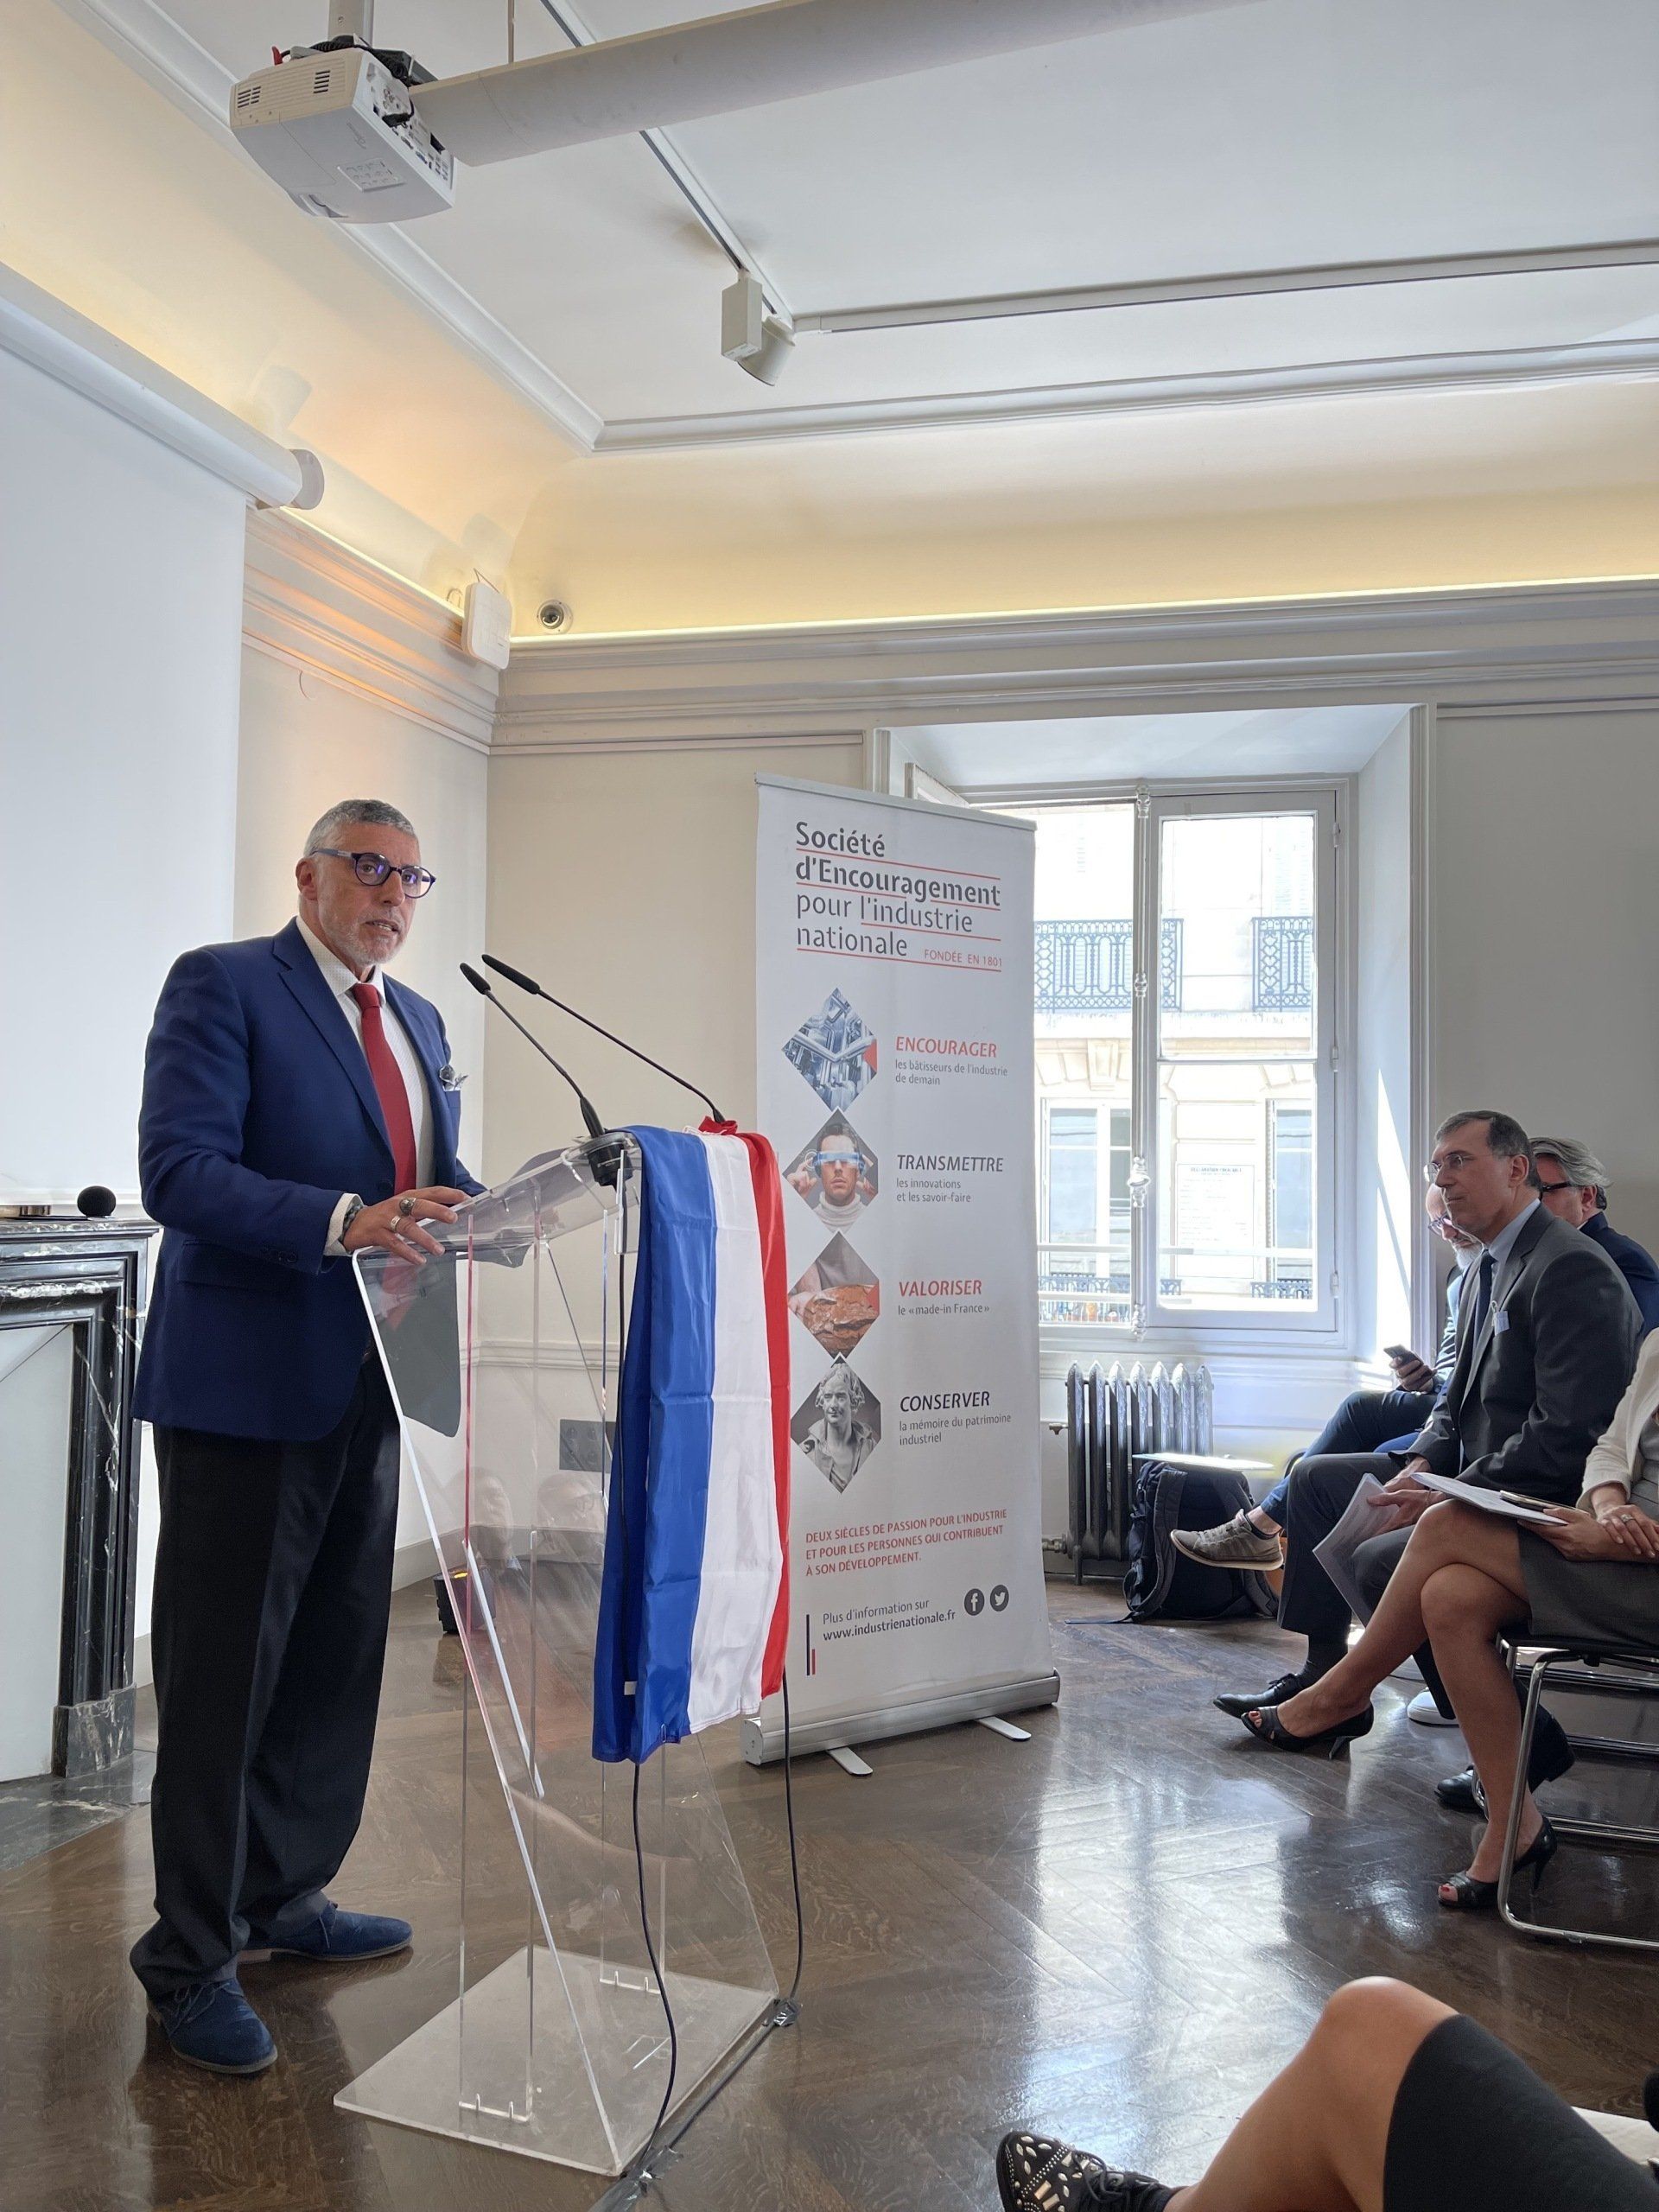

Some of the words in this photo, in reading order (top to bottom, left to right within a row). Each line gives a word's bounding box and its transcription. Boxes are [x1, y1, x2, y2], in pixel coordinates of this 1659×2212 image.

[796, 821, 886, 857] Société
[796, 855, 1001, 906] d'Encouragement
[797, 893, 852, 918] pour
[861, 895, 973, 933] l'industrie
[797, 926, 907, 957] nationale
[925, 949, 963, 963] FONDÉE
[968, 954, 980, 964] EN
[983, 956, 1002, 967] 1801
[896, 1036, 997, 1058] ENCOURAGER
[895, 1059, 907, 1070] les
[909, 1060, 952, 1073] bâtisseurs
[954, 1064, 965, 1073] de
[967, 1064, 1008, 1077] l'industrie
[895, 1073, 906, 1083] de
[908, 1073, 940, 1085] demain
[897, 1154, 1004, 1173] TRANSMETTRE
[896, 1178, 908, 1188] les
[911, 1179, 961, 1189] innovations
[896, 1192, 906, 1202] et
[908, 1192, 919, 1202] les
[922, 1192, 971, 1203] savoir-faire
[899, 1280, 982, 1296] VALORISER
[898, 1305, 906, 1315] le
[899, 1391, 990, 1412] CONSERVER
[899, 1421, 907, 1431] la
[909, 1418, 950, 1430] mémoire
[951, 1416, 963, 1427] du
[965, 1413, 1012, 1428] patrimoine
[899, 1433, 942, 1446] industriel
[805, 1531, 832, 1543] DEUX
[835, 1525, 870, 1541] SIÈCLES
[873, 1524, 886, 1535] DE
[887, 1518, 927, 1533] PASSION
[930, 1515, 955, 1529] POUR
[957, 1509, 1007, 1524] L'INDUSTRIE
[806, 1549, 817, 1560] ET
[819, 1545, 847, 1559] POUR
[849, 1542, 865, 1554] LES
[868, 1535, 923, 1553] PERSONNES
[925, 1532, 941, 1544] QUI
[943, 1524, 1003, 1541] CONTRIBUENT
[805, 1564, 813, 1576] À
[815, 1562, 836, 1575] SON
[823, 1612, 843, 1624] Plus
[846, 1603, 912, 1621] d'information
[915, 1599, 930, 1611] sur
[823, 1609, 956, 1641] www.industrienationale.fr
